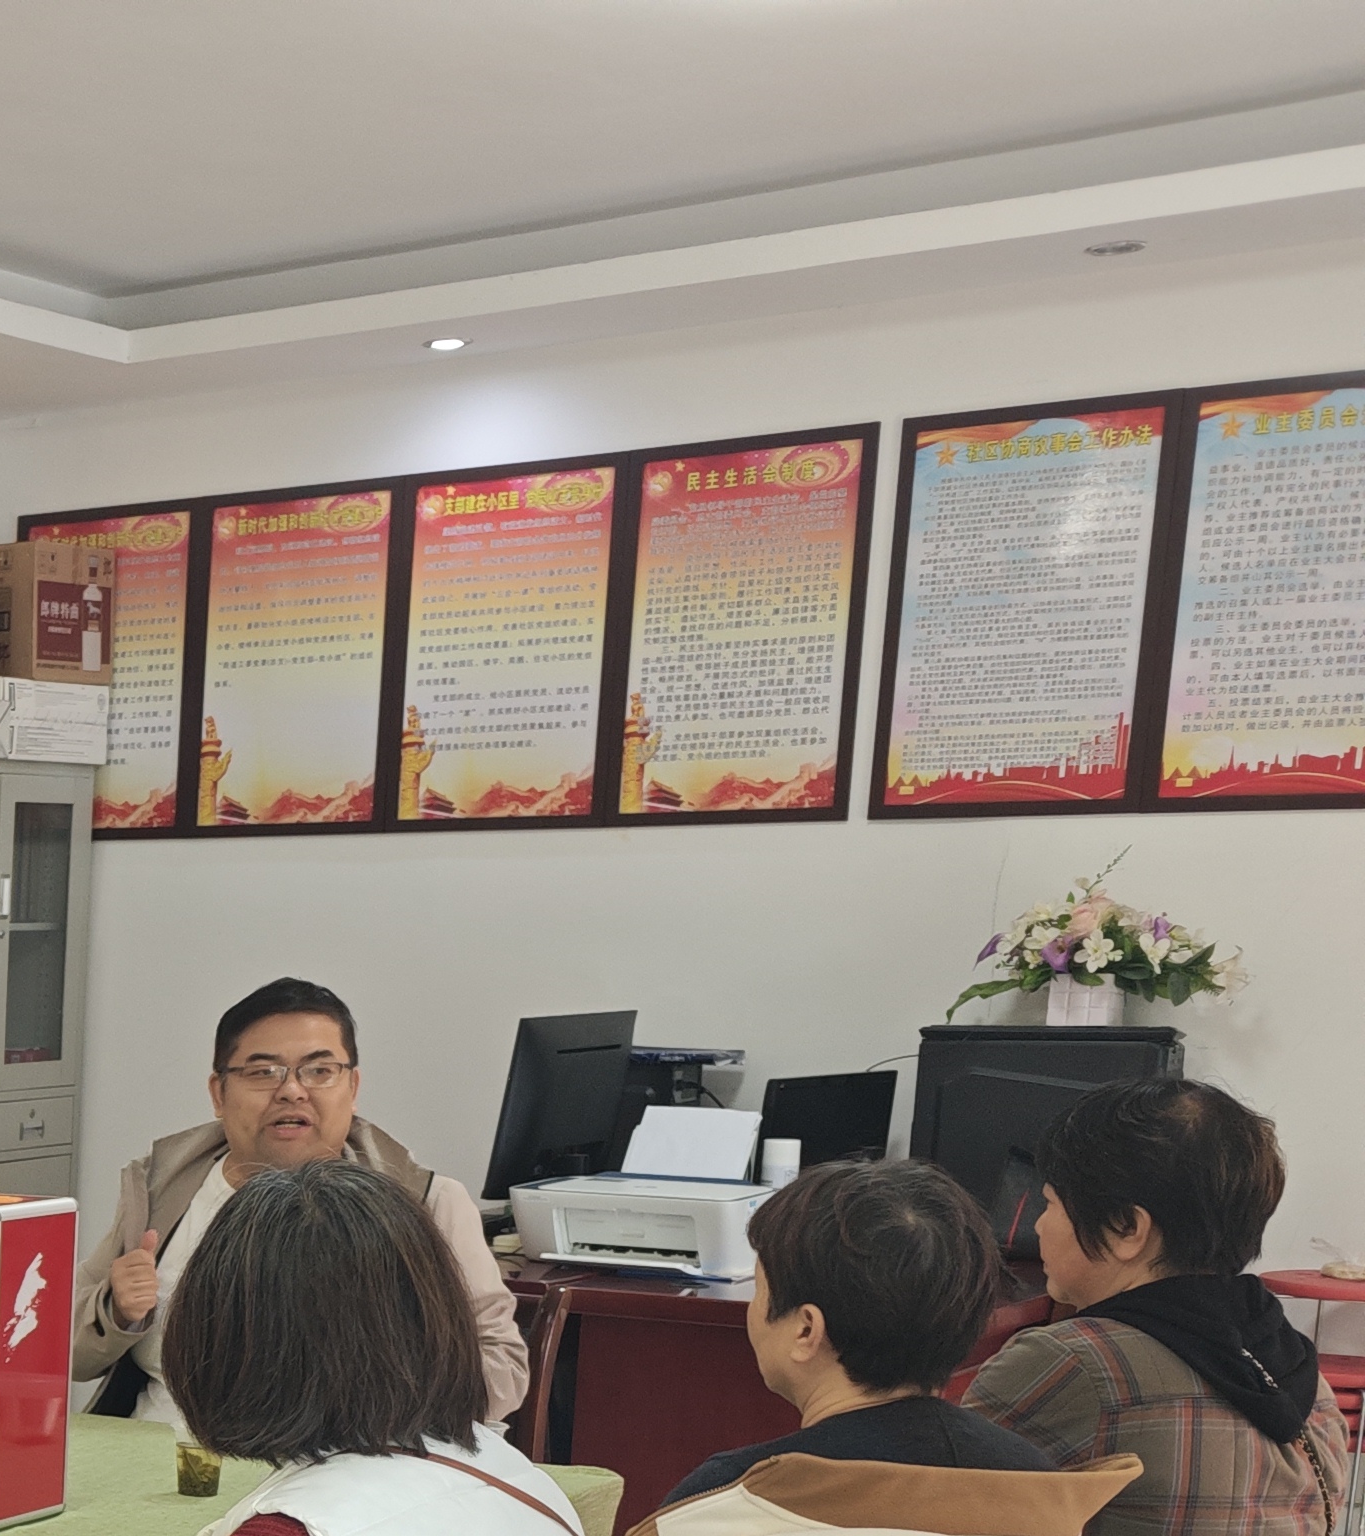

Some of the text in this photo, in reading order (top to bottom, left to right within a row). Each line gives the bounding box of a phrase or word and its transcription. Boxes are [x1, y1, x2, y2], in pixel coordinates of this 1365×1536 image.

[1253, 403, 1365, 435] 业主委员会
[967, 424, 1153, 463] 社区协商议事会工作办法
[686, 460, 817, 492] 民主生活会制度
